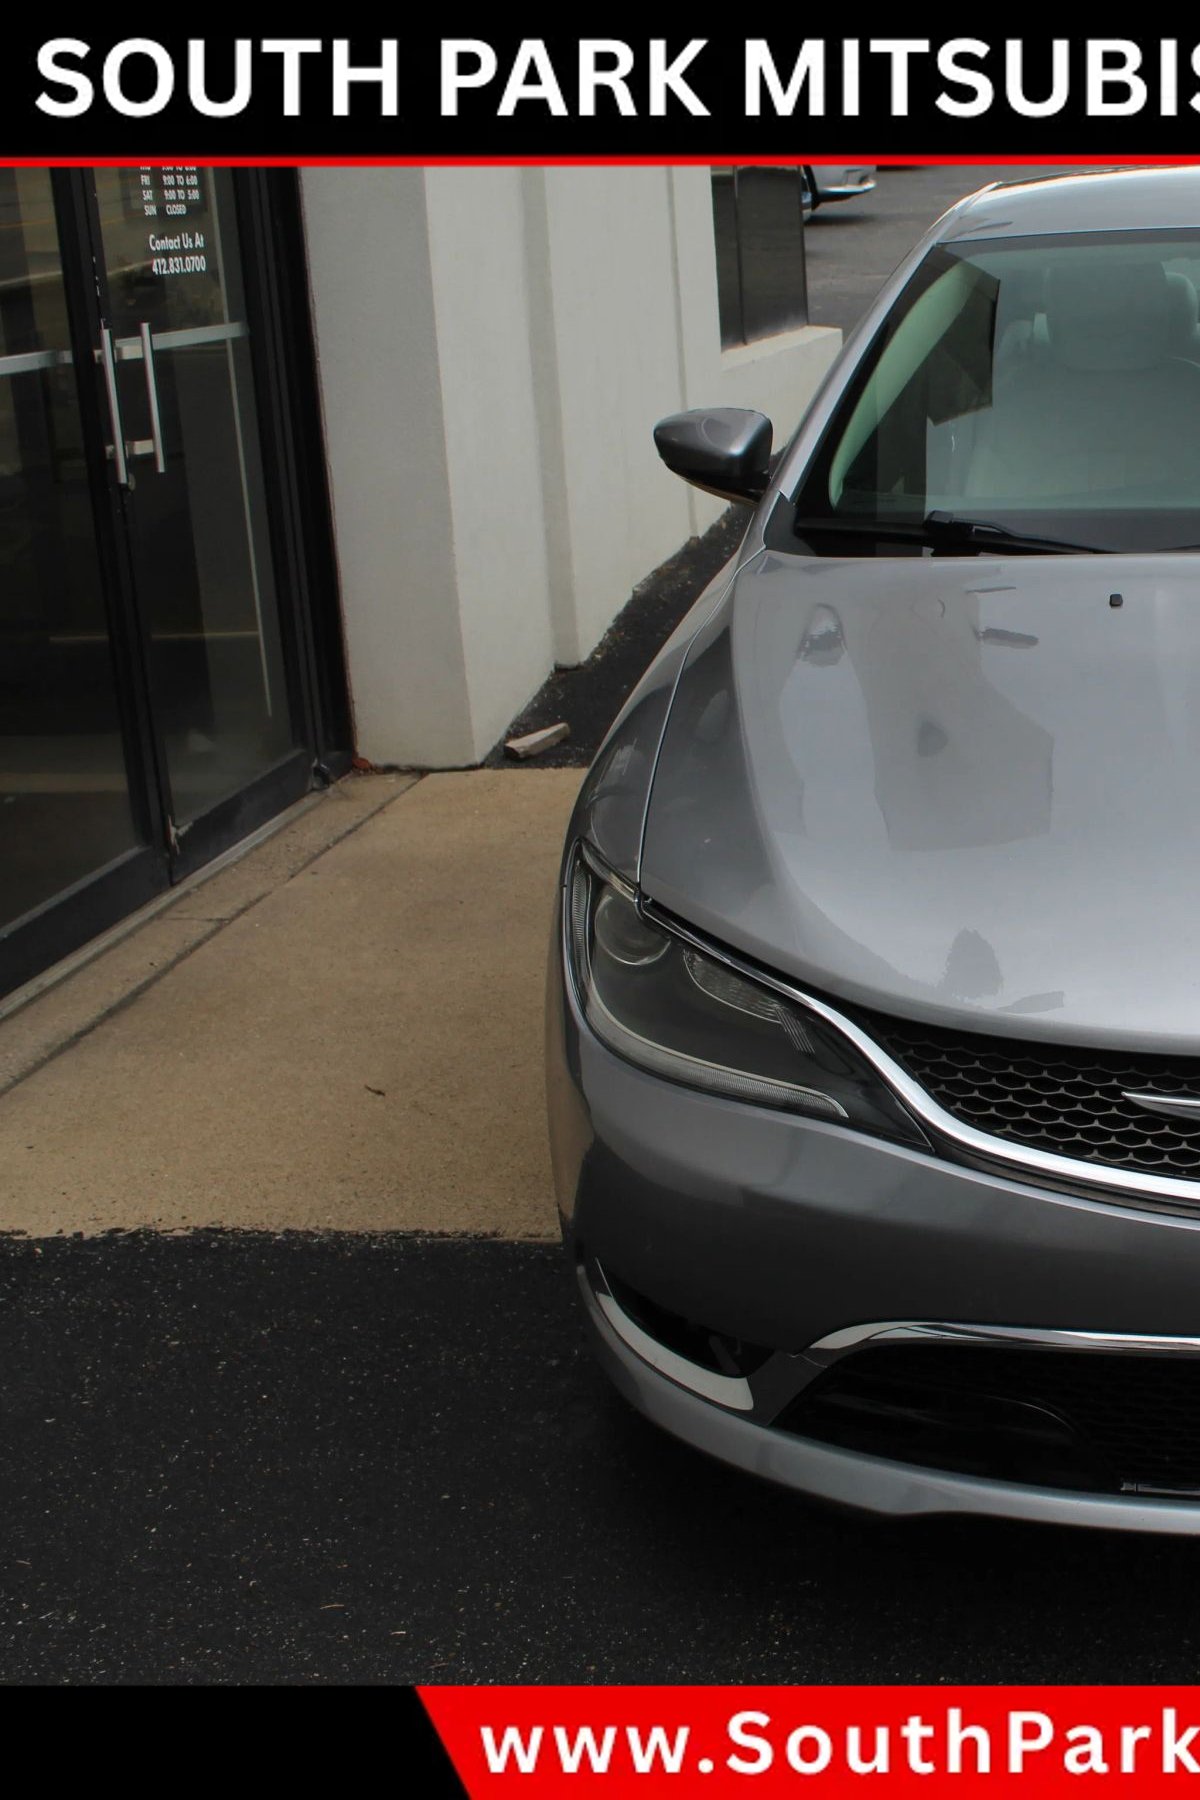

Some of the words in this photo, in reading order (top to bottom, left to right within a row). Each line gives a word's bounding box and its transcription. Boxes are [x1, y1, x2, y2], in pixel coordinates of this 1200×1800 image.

[140, 175, 151, 186] FRI
[176, 175, 185, 186] TO
[142, 189, 153, 201] SAT
[177, 189, 186, 201] TO
[144, 204, 157, 216] SUN
[166, 204, 187, 216] CLOSED
[149, 234, 181, 251] Contact
[182, 232, 193, 249] Us
[195, 232, 204, 248] At
[152, 255, 206, 275] 412.831.0700
